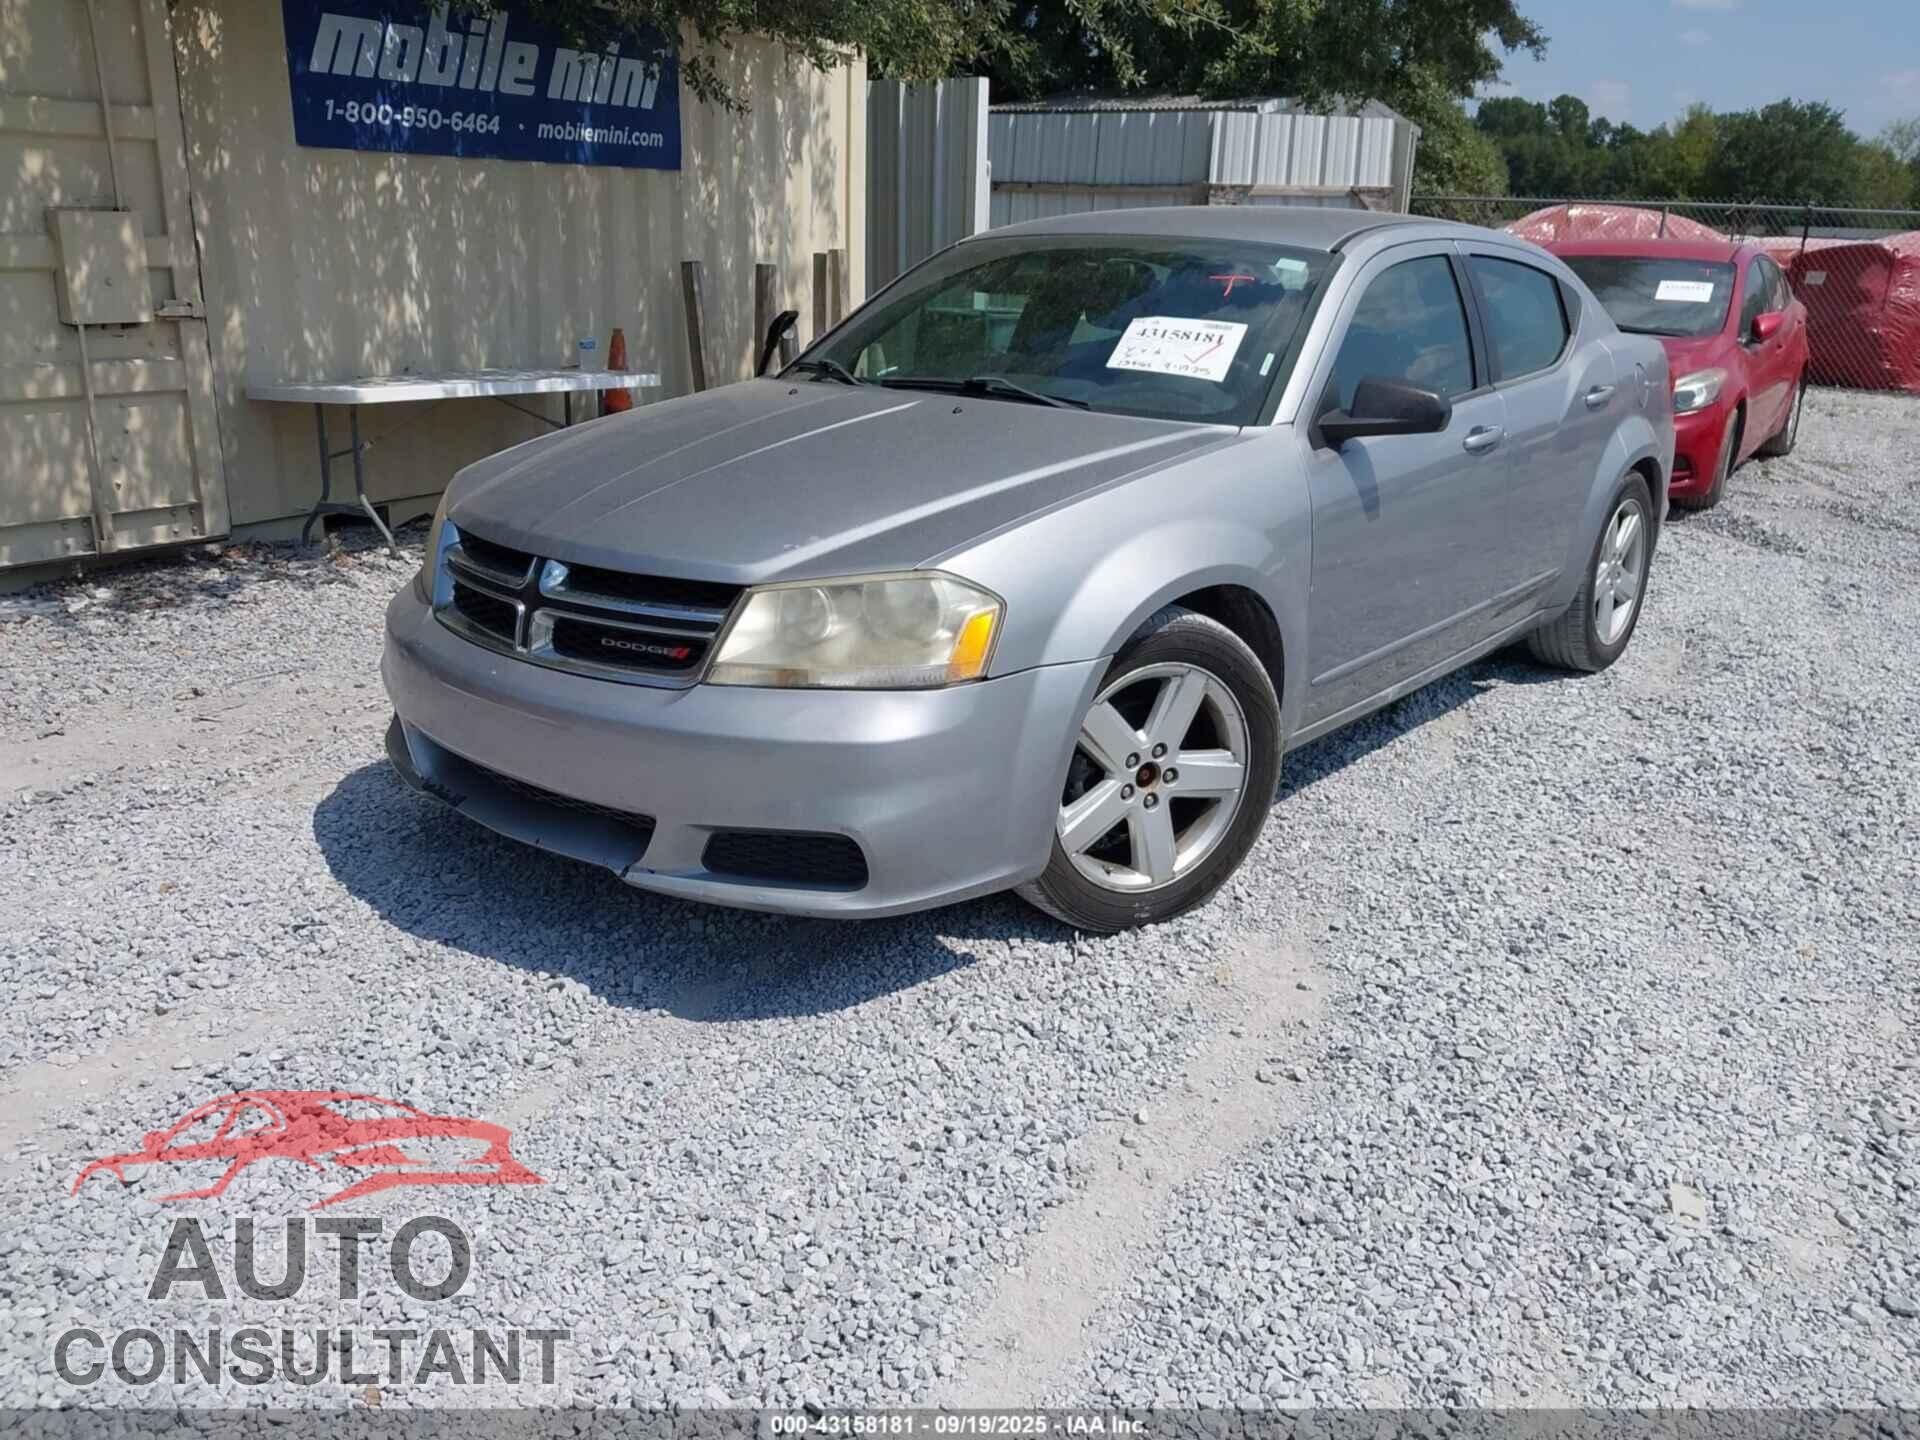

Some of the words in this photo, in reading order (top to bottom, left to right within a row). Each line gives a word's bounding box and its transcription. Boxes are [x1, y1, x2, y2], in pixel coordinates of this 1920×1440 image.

[309, 1, 539, 96] mobile
[547, 41, 665, 110] mini
[324, 99, 500, 135] 1-800-950-6464
[537, 119, 663, 149] mobilemini.com
[1135, 327, 1225, 345] 43158181
[600, 637, 674, 659] DODGE
